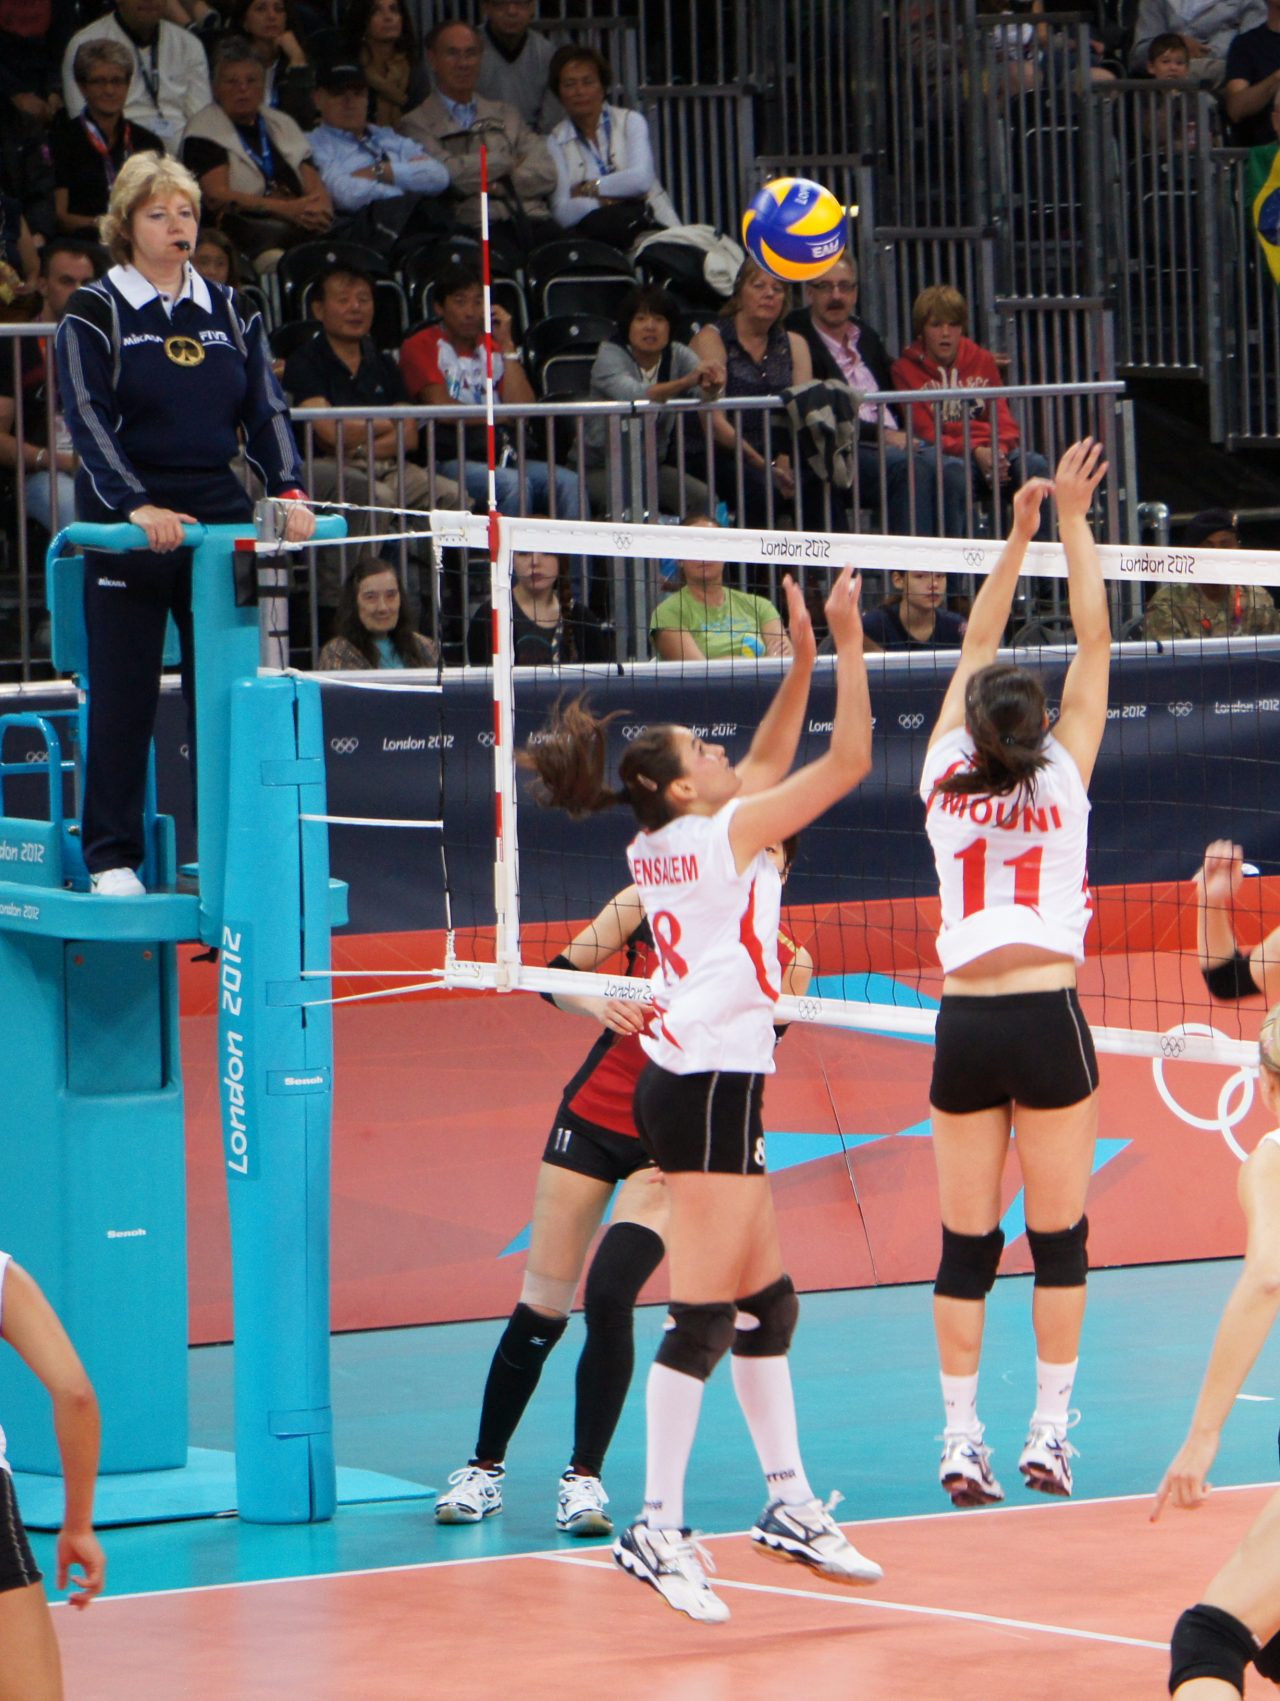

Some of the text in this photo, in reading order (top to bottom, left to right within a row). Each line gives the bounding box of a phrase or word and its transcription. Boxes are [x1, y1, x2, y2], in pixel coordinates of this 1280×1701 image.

[760, 537, 831, 558] London 2012
[1120, 553, 1195, 574] London 2012
[1122, 705, 1147, 718] 2012
[711, 723, 736, 737] 2012
[383, 737, 425, 751] London
[939, 791, 1063, 833] MOUNI
[0, 840, 45, 863] don 2012
[631, 854, 699, 887] ENSALEM
[954, 837, 1044, 920] 11
[0, 902, 40, 920] ondon 2012
[604, 980, 643, 1000] London
[222, 925, 249, 1175] London 2012
[555, 1128, 571, 1152] 11
[754, 1136, 766, 1167] 8
